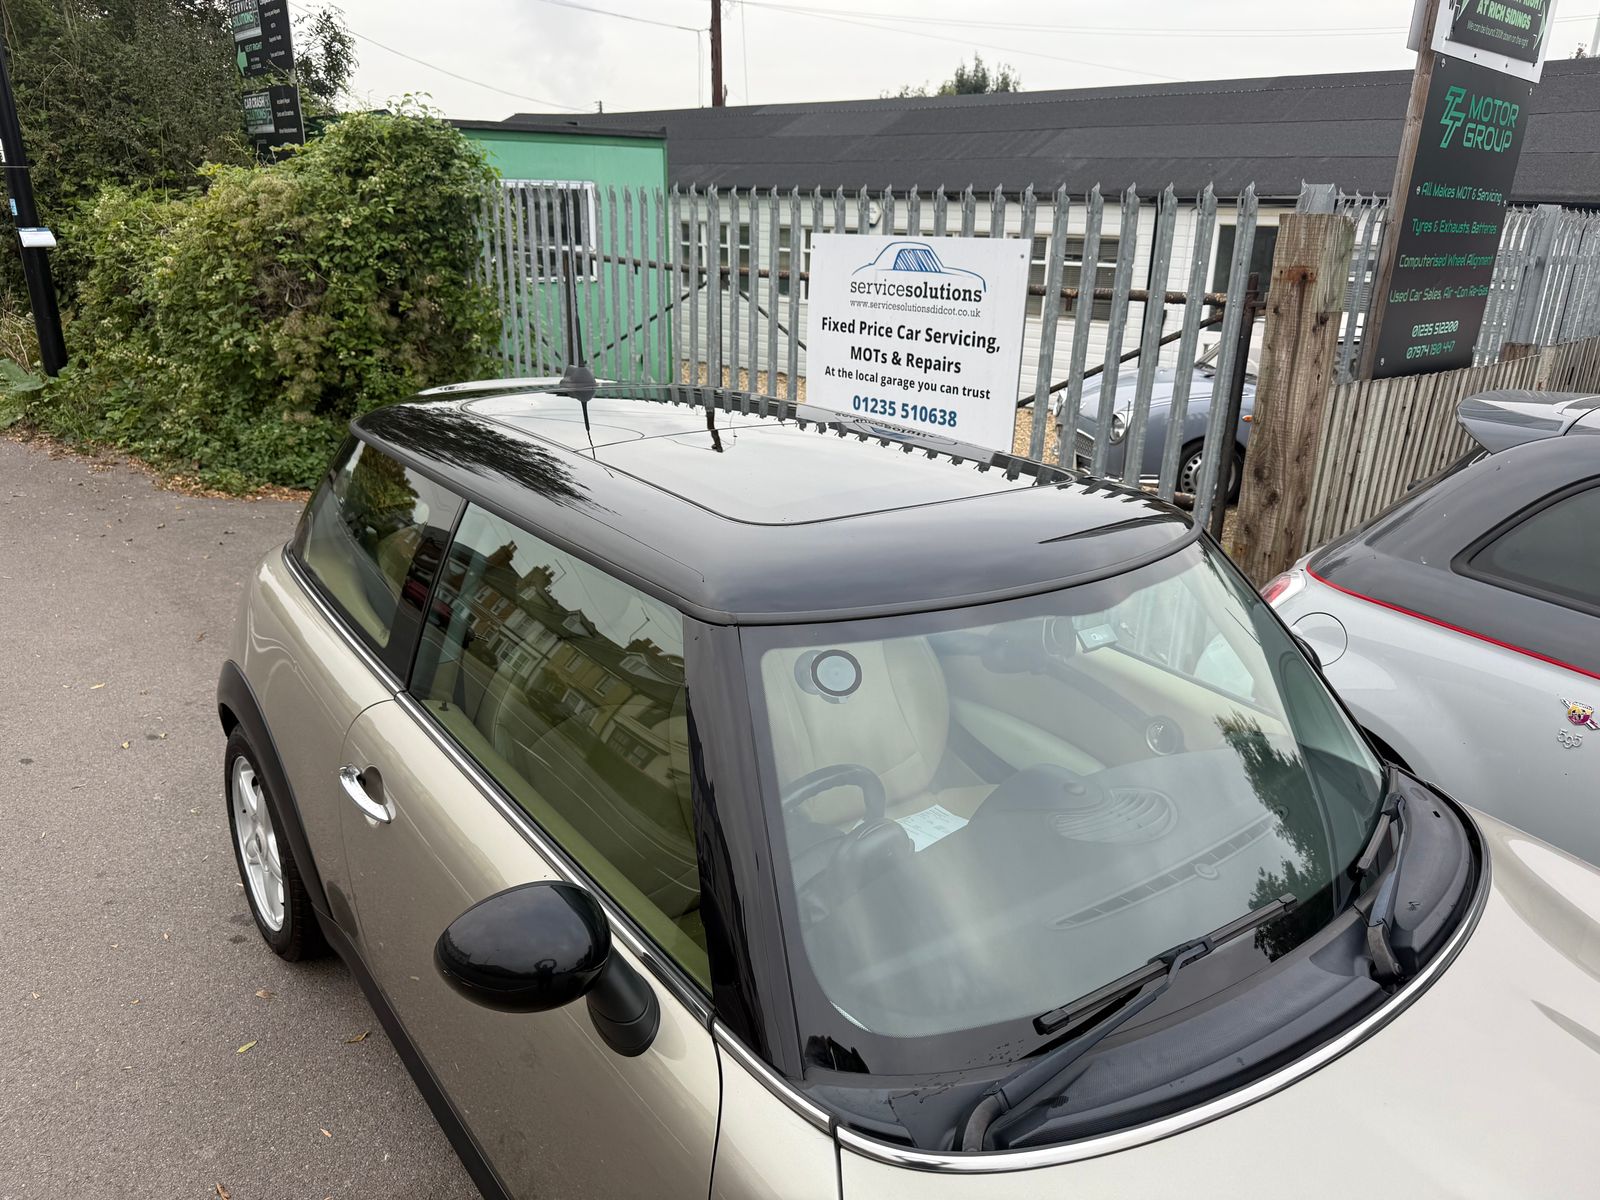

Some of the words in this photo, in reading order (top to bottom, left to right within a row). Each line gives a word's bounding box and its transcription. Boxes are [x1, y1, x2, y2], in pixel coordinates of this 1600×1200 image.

[1476, 0, 1489, 15] AT
[1488, 1, 1506, 21] RICH
[1504, 6, 1532, 30] SIDINGS
[1523, 0, 1543, 10] GHT
[1468, 94, 1520, 128] MOTOR
[1463, 122, 1512, 152] GROUP
[1421, 182, 1432, 196] All
[1432, 184, 1455, 198] Makes
[1456, 186, 1472, 199] MOT
[1472, 188, 1476, 200] &
[1476, 188, 1502, 206] Servicing
[1412, 218, 1432, 236] Tyres
[1433, 221, 1438, 232] &
[1471, 222, 1497, 234] Batteries
[1399, 253, 1447, 270] Computerised
[1447, 253, 1466, 267] Wheel
[1466, 253, 1493, 269] Alignment
[850, 278, 982, 302] servicesolutions
[1390, 288, 1409, 302] Used
[1409, 289, 1422, 301] Car
[850, 299, 981, 318] www.servicesolutionsdidcot.co.uk
[822, 317, 855, 333] Fixed
[859, 322, 893, 338] Price
[897, 325, 921, 341] Car
[925, 327, 1000, 354] Servicing,
[1412, 323, 1434, 337] 01235
[1434, 320, 1459, 335] 512200
[850, 346, 888, 364] MOTs
[892, 351, 902, 366] &
[906, 353, 962, 374] Repairs
[1406, 344, 1430, 359] 07974
[825, 366, 835, 376] At
[837, 368, 853, 380] the
[855, 370, 878, 382] local
[880, 375, 915, 390] garage
[918, 380, 937, 392] you
[940, 384, 959, 395] can
[962, 386, 991, 400] trust
[853, 395, 896, 416] 01235
[901, 403, 957, 427] 510638
[1558, 728, 1583, 749] 595
